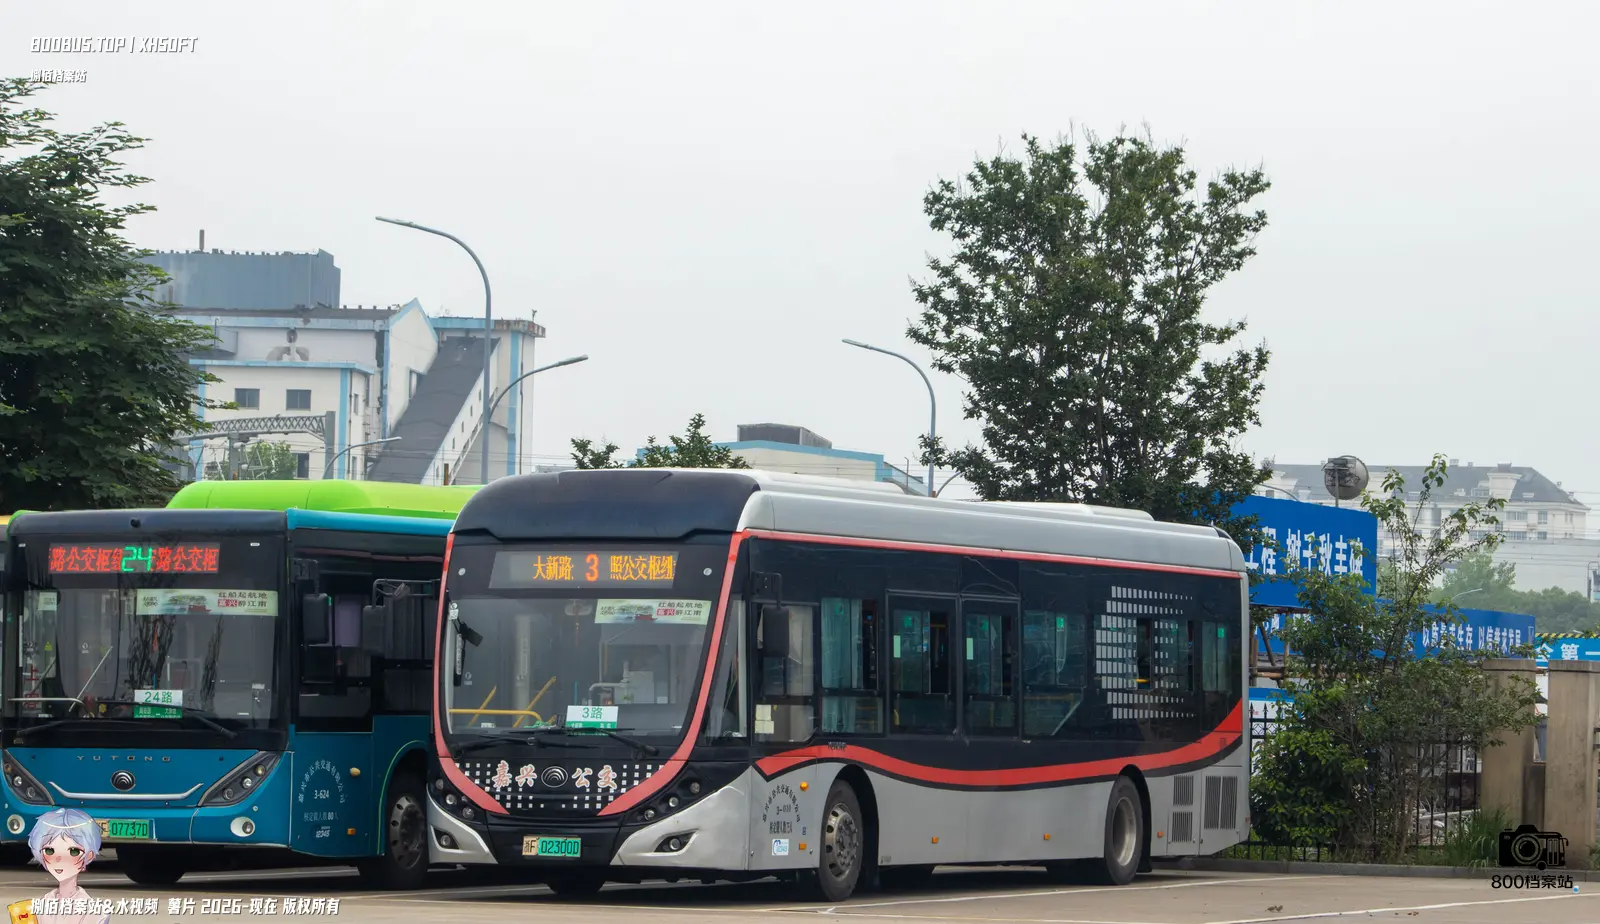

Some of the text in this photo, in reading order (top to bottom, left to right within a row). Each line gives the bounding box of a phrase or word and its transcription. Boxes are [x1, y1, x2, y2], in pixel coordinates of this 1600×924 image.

[121, 546, 152, 572] 24
[585, 554, 599, 581] 3
[145, 691, 172, 704] 24路
[582, 707, 603, 719] 3路
[492, 760, 617, 789] 嘉兴 公交
